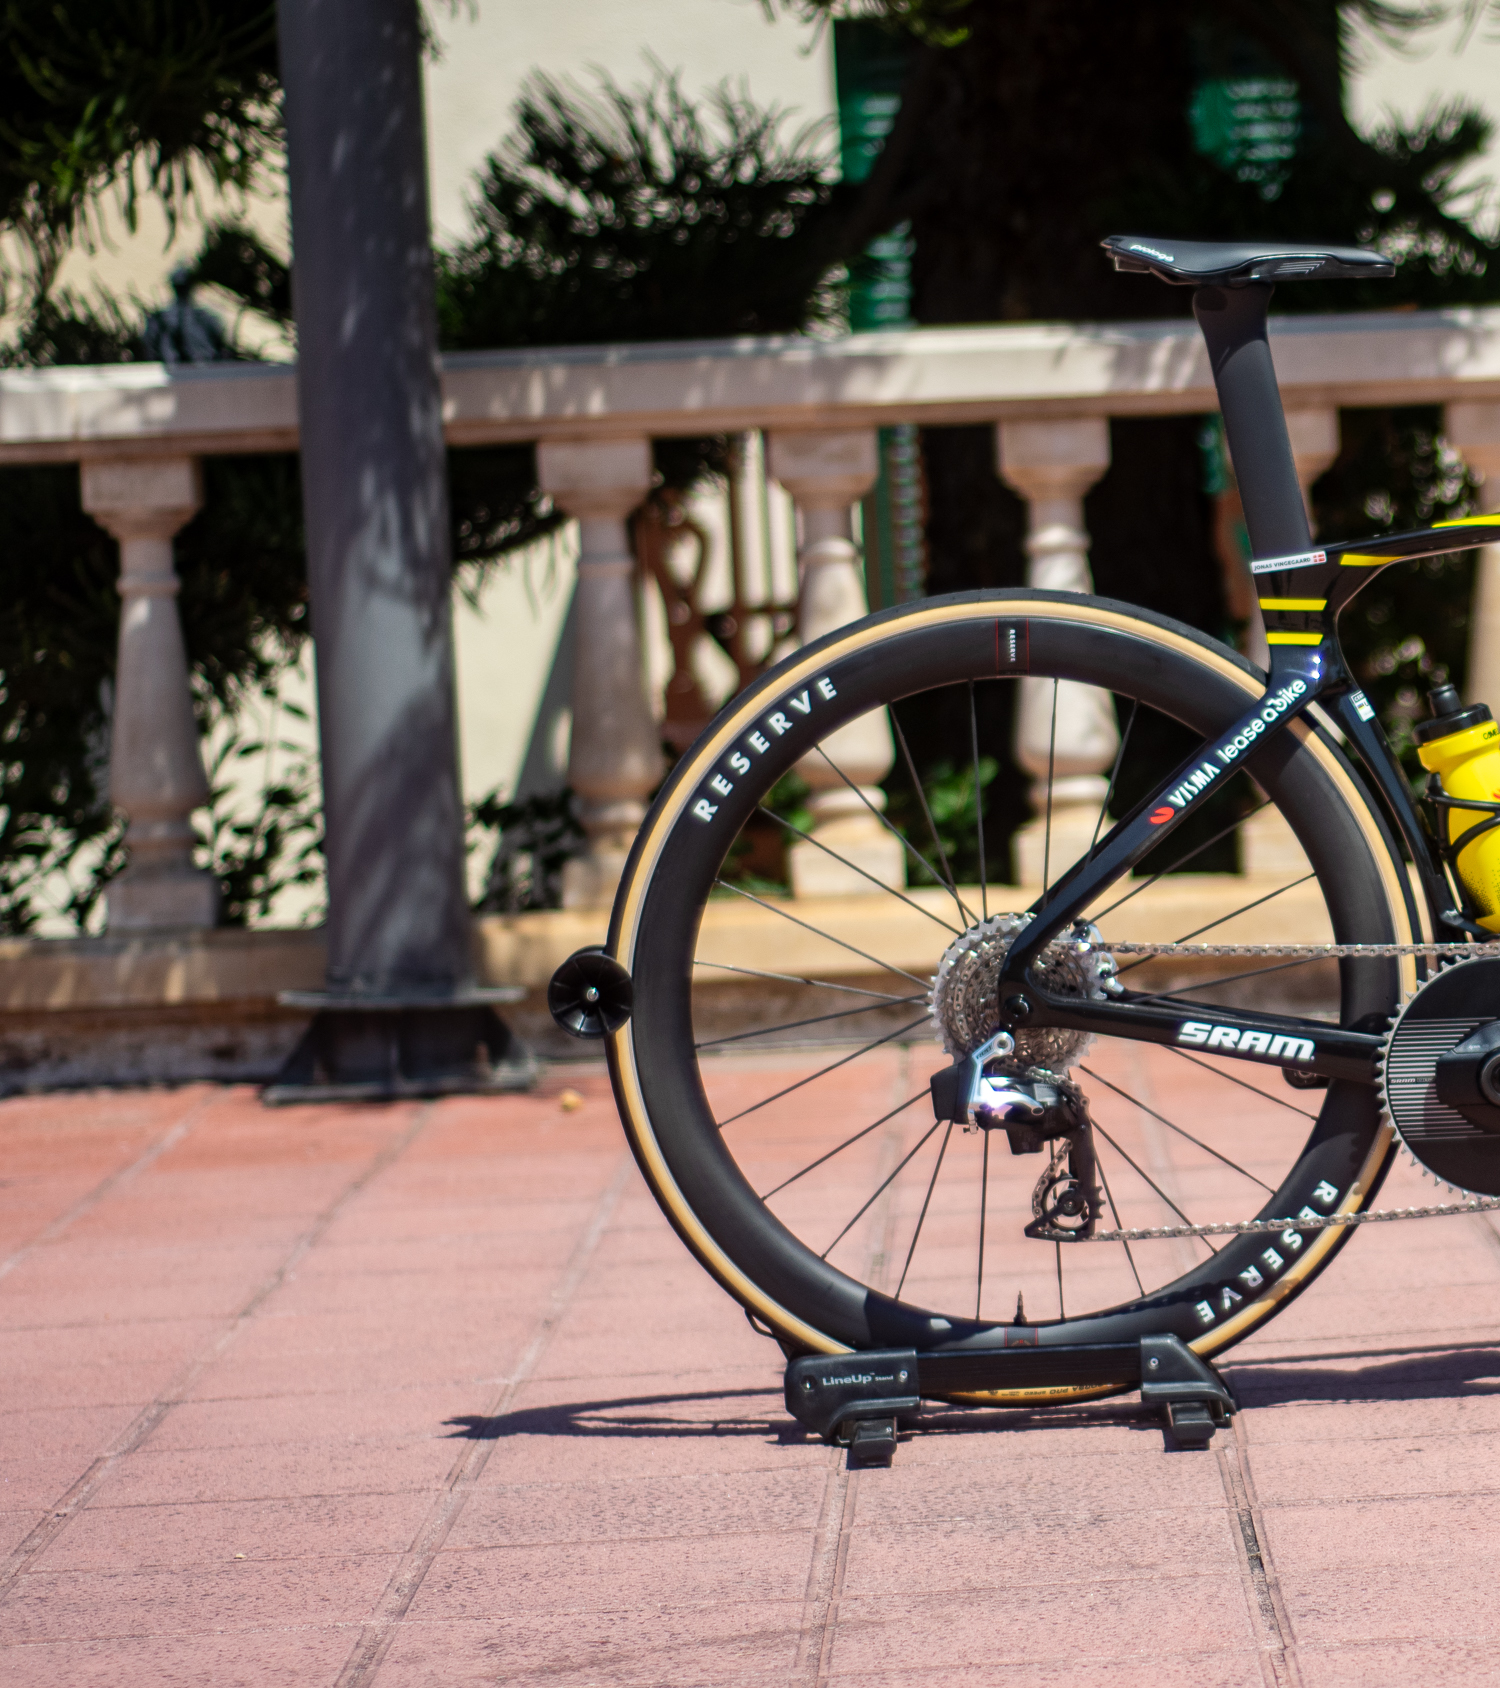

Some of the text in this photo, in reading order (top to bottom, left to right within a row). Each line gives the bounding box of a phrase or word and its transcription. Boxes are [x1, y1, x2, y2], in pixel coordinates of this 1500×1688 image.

[1254, 557, 1311, 571] JONAS VINGEGAARD
[693, 677, 838, 822] RESERVE
[1168, 761, 1221, 807] VISMA
[1216, 718, 1266, 764] lease
[1178, 1021, 1316, 1060] SRAM
[822, 1374, 872, 1386] LineUp
